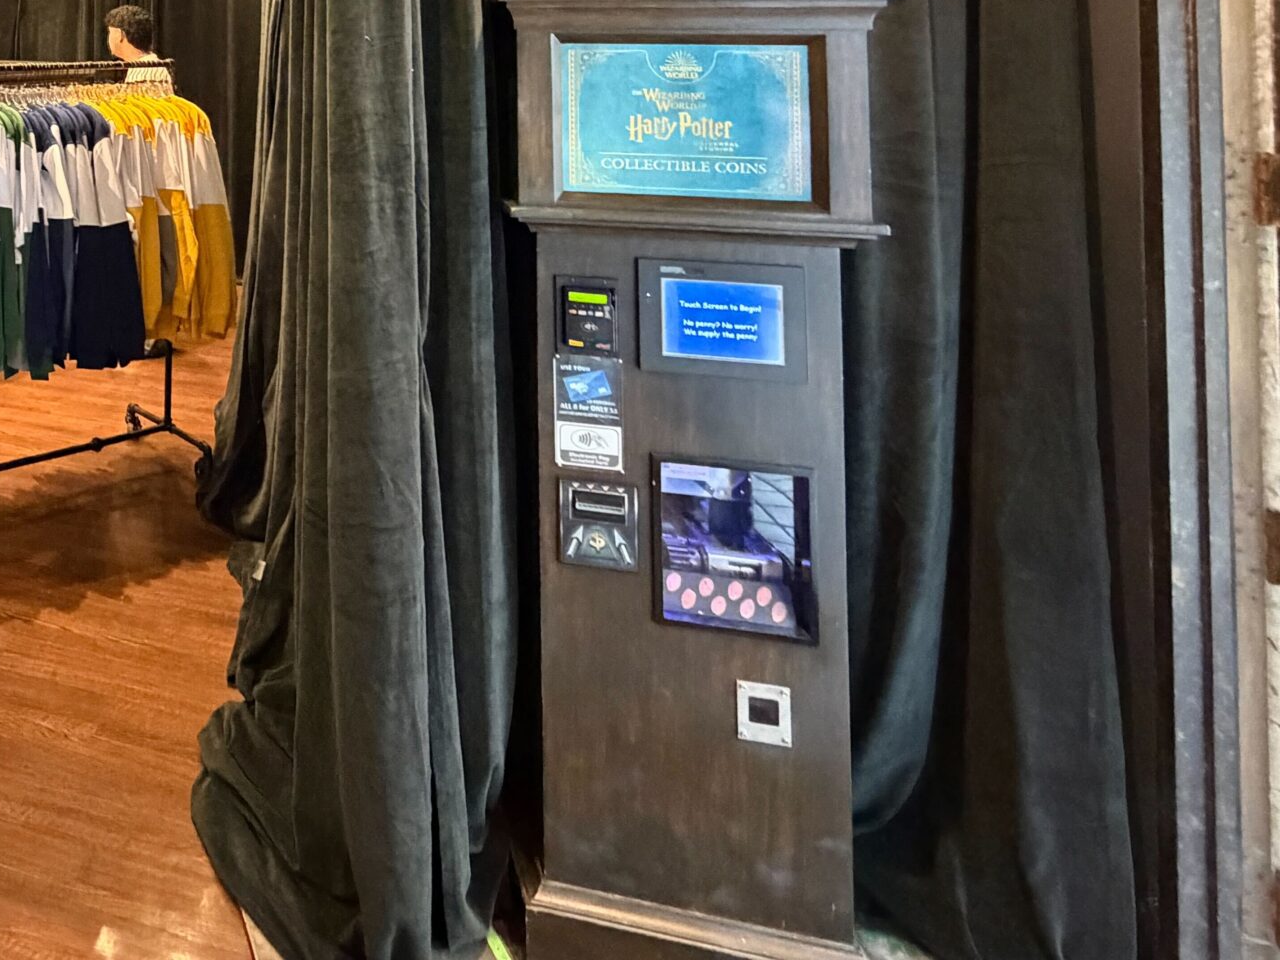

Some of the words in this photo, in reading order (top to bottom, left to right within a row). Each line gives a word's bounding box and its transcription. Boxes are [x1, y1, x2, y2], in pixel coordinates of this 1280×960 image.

[625, 113, 677, 143] Harry
[679, 112, 733, 139] Potter
[600, 157, 710, 172] COLLECTIBLE
[714, 162, 767, 175] COINS
[679, 300, 701, 309] Touch
[702, 302, 729, 310] Screen
[729, 303, 738, 311] to
[739, 303, 761, 314] Begin!
[683, 318, 694, 327] No
[695, 320, 721, 329] penny?
[721, 321, 733, 329] No
